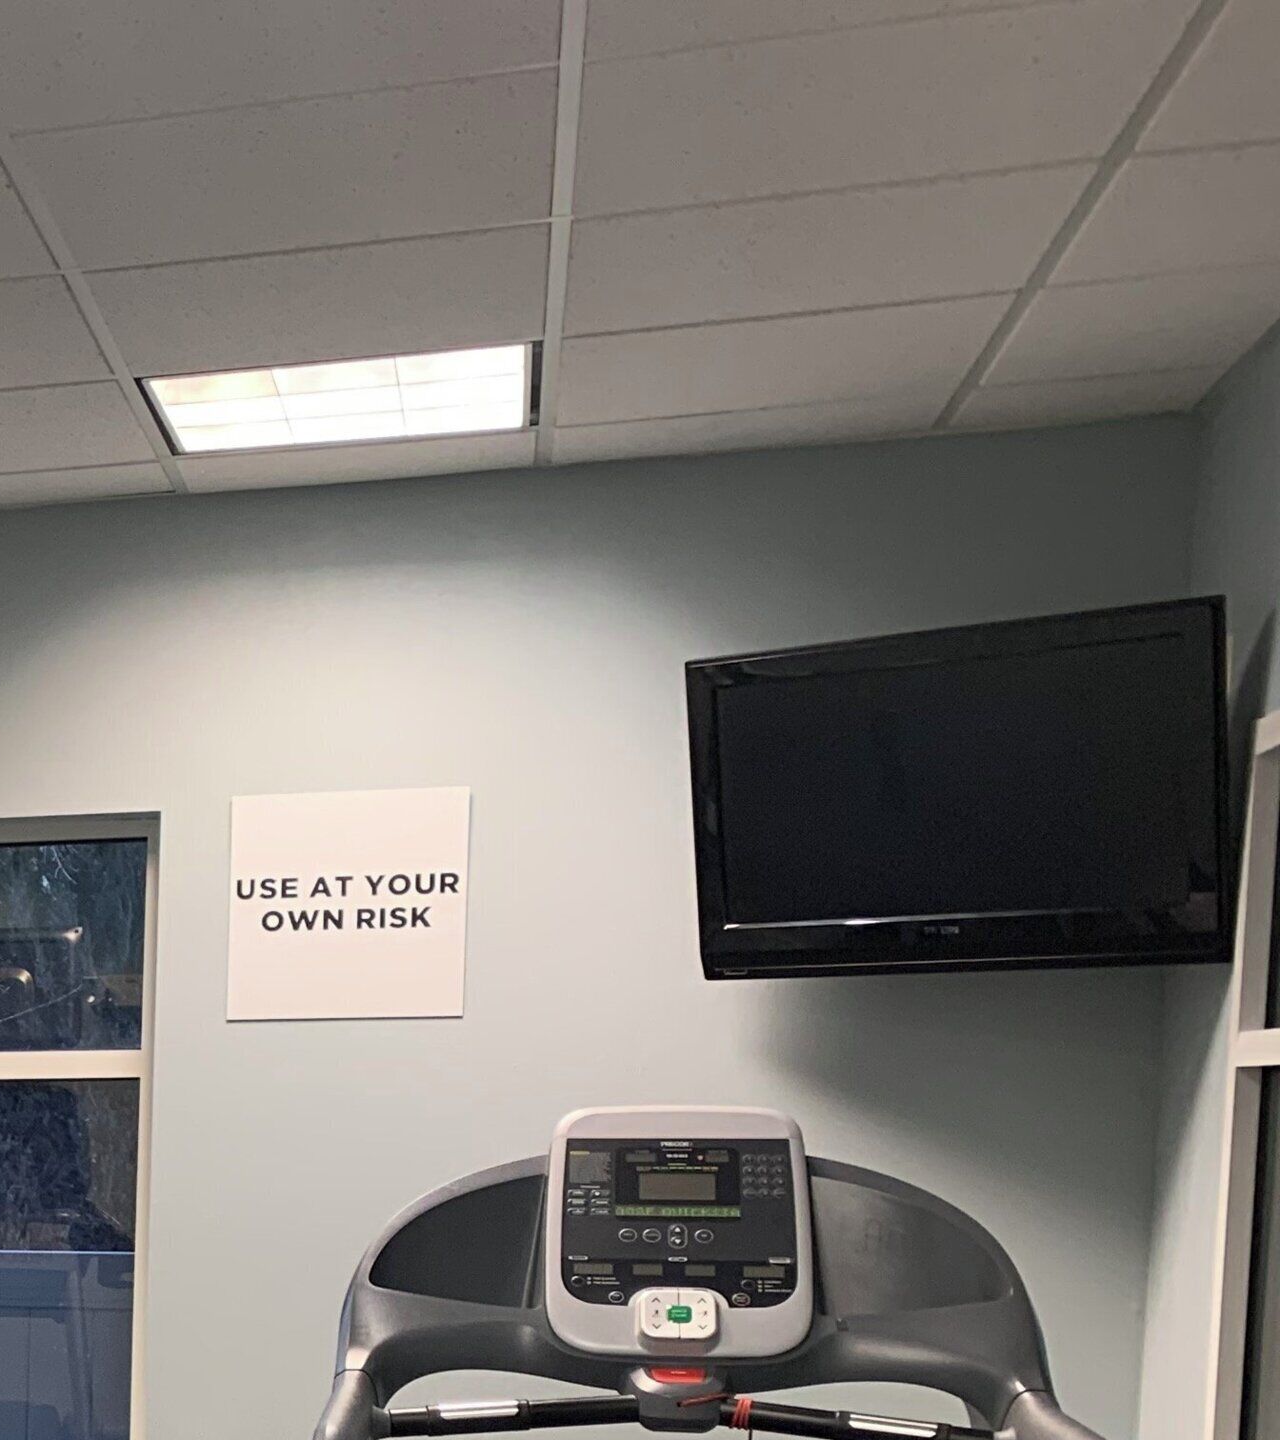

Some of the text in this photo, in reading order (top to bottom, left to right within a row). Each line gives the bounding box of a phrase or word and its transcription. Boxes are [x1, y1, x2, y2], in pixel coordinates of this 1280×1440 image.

[236, 872, 460, 900] USE AT YOUR
[261, 906, 432, 932] OWN RISK
